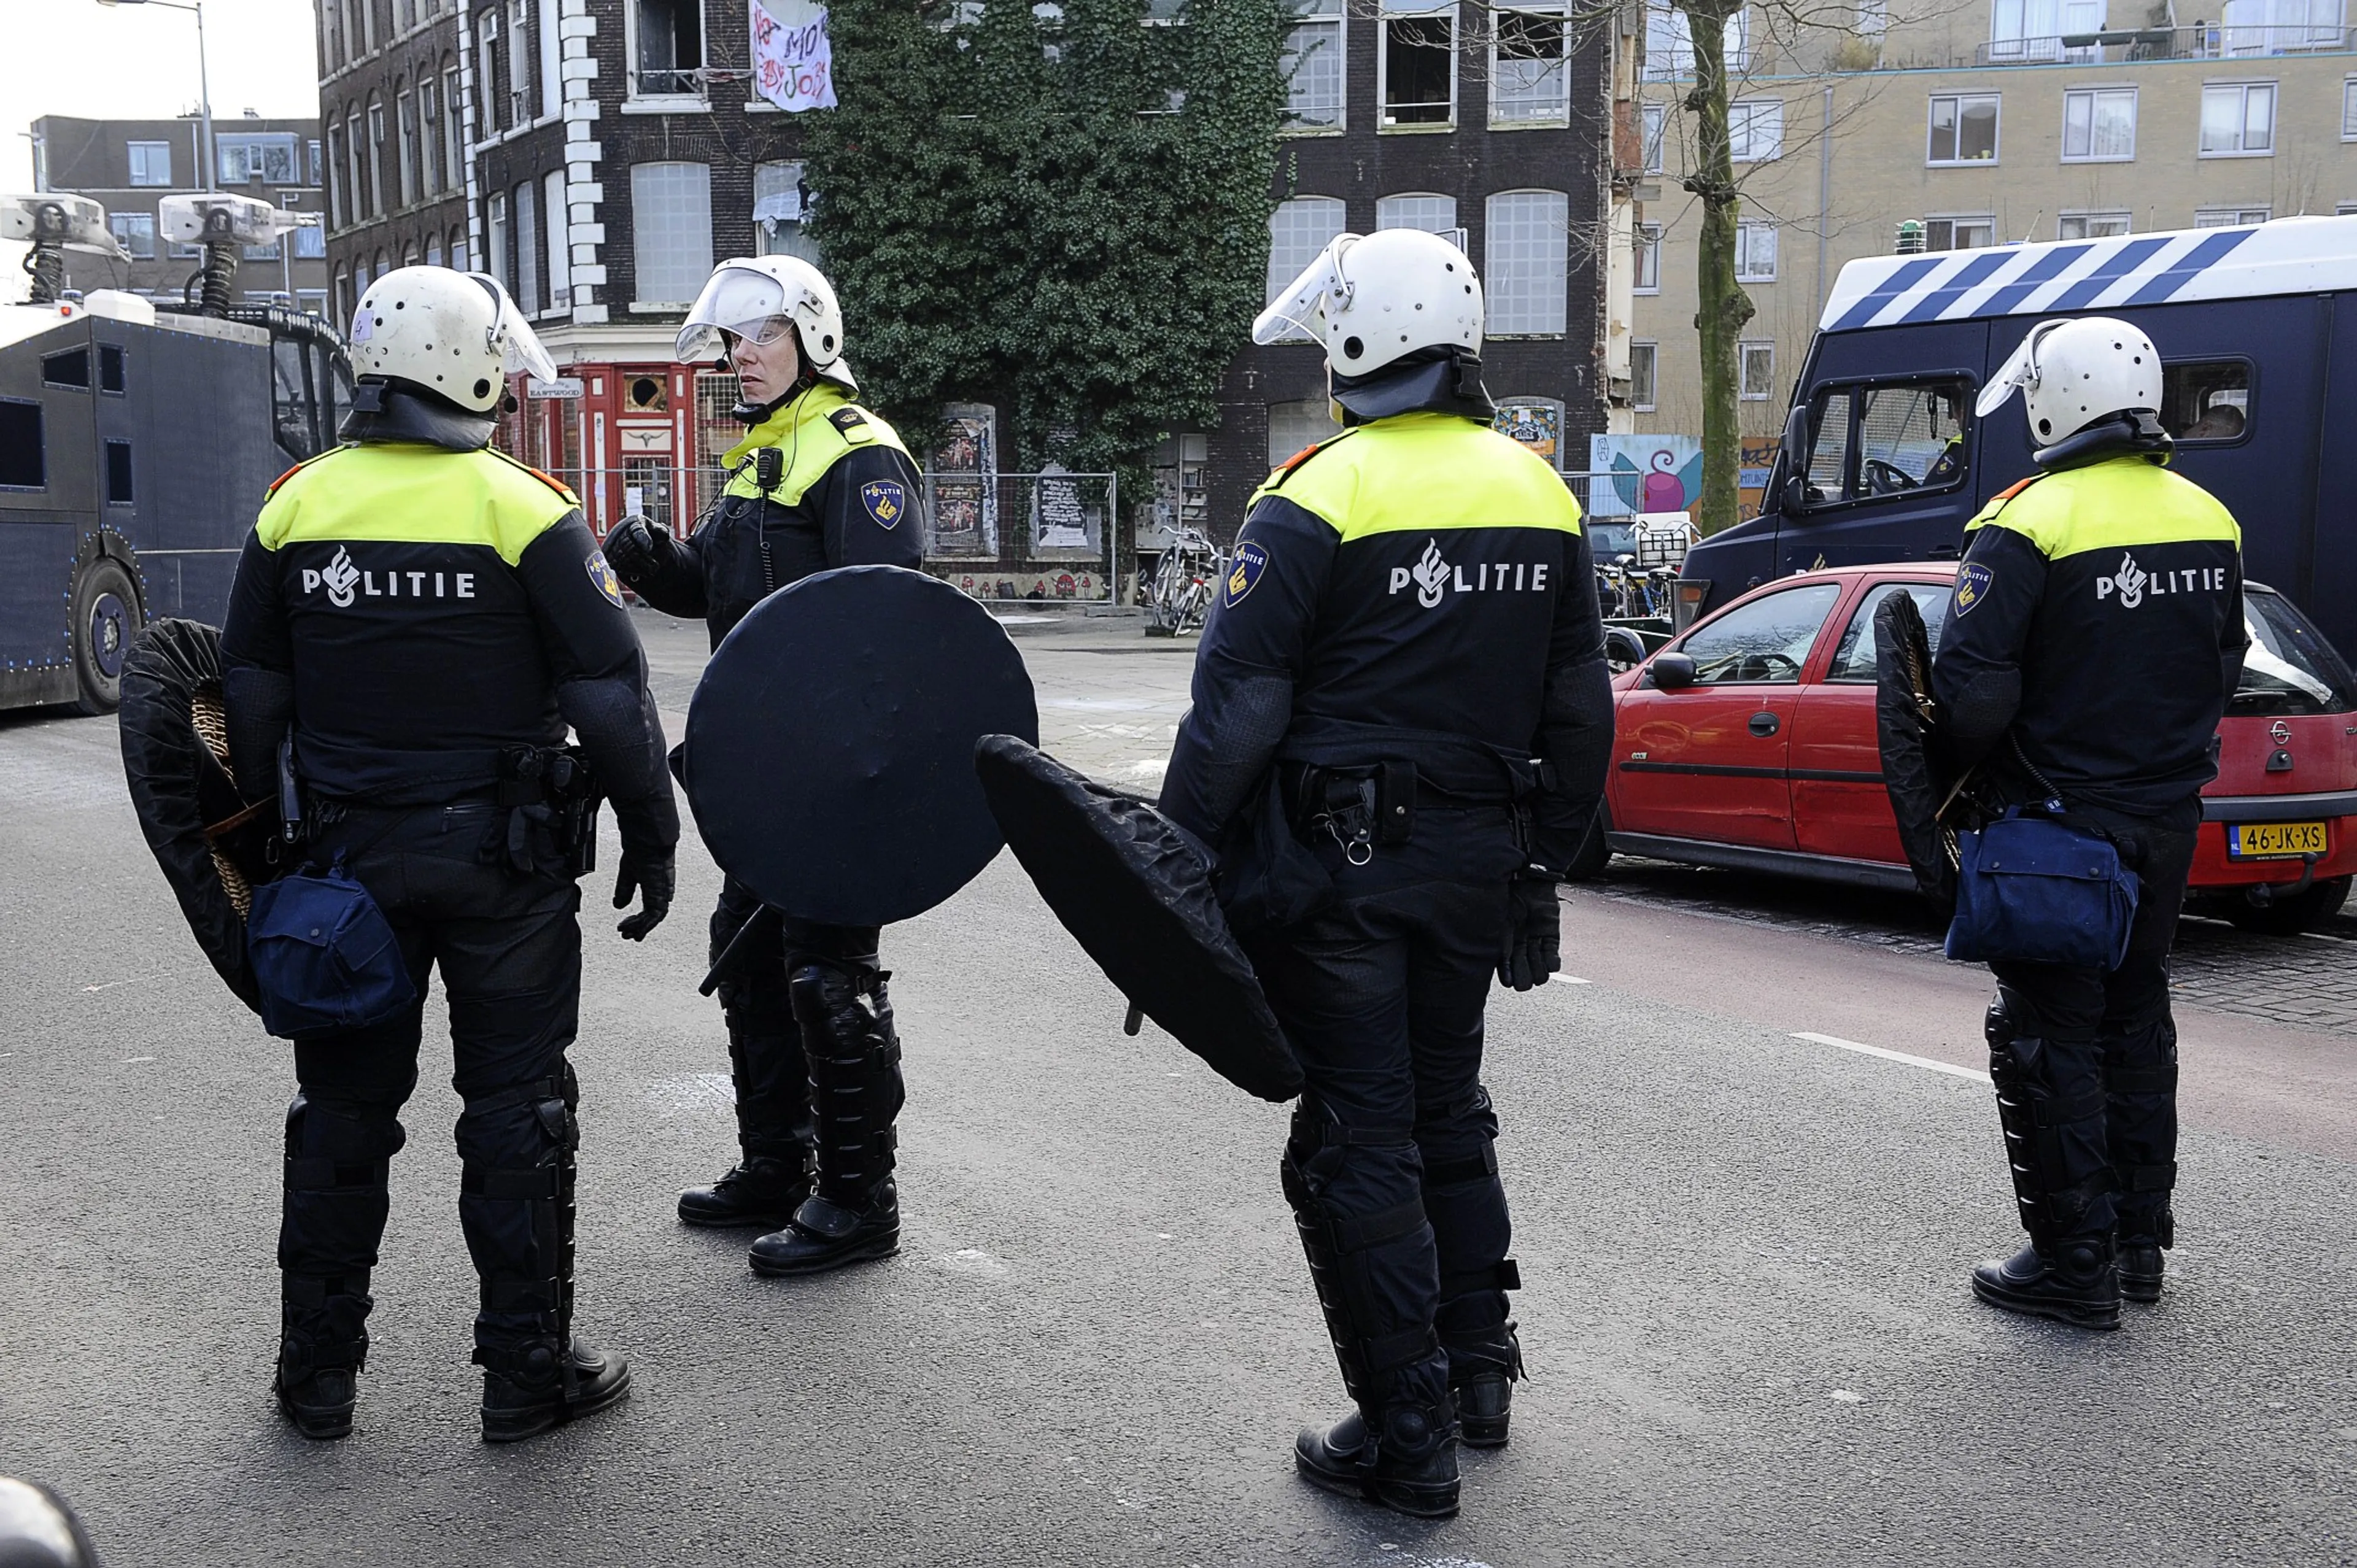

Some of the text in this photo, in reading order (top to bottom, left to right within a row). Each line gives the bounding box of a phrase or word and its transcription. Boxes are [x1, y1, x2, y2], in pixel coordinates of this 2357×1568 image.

[865, 488, 900, 497] POLITIE
[303, 568, 475, 608] POLITIE
[1389, 563, 1549, 608] POLITIE
[2097, 568, 2226, 609] POLITIE
[2247, 826, 2321, 850] 46-JK-XS
